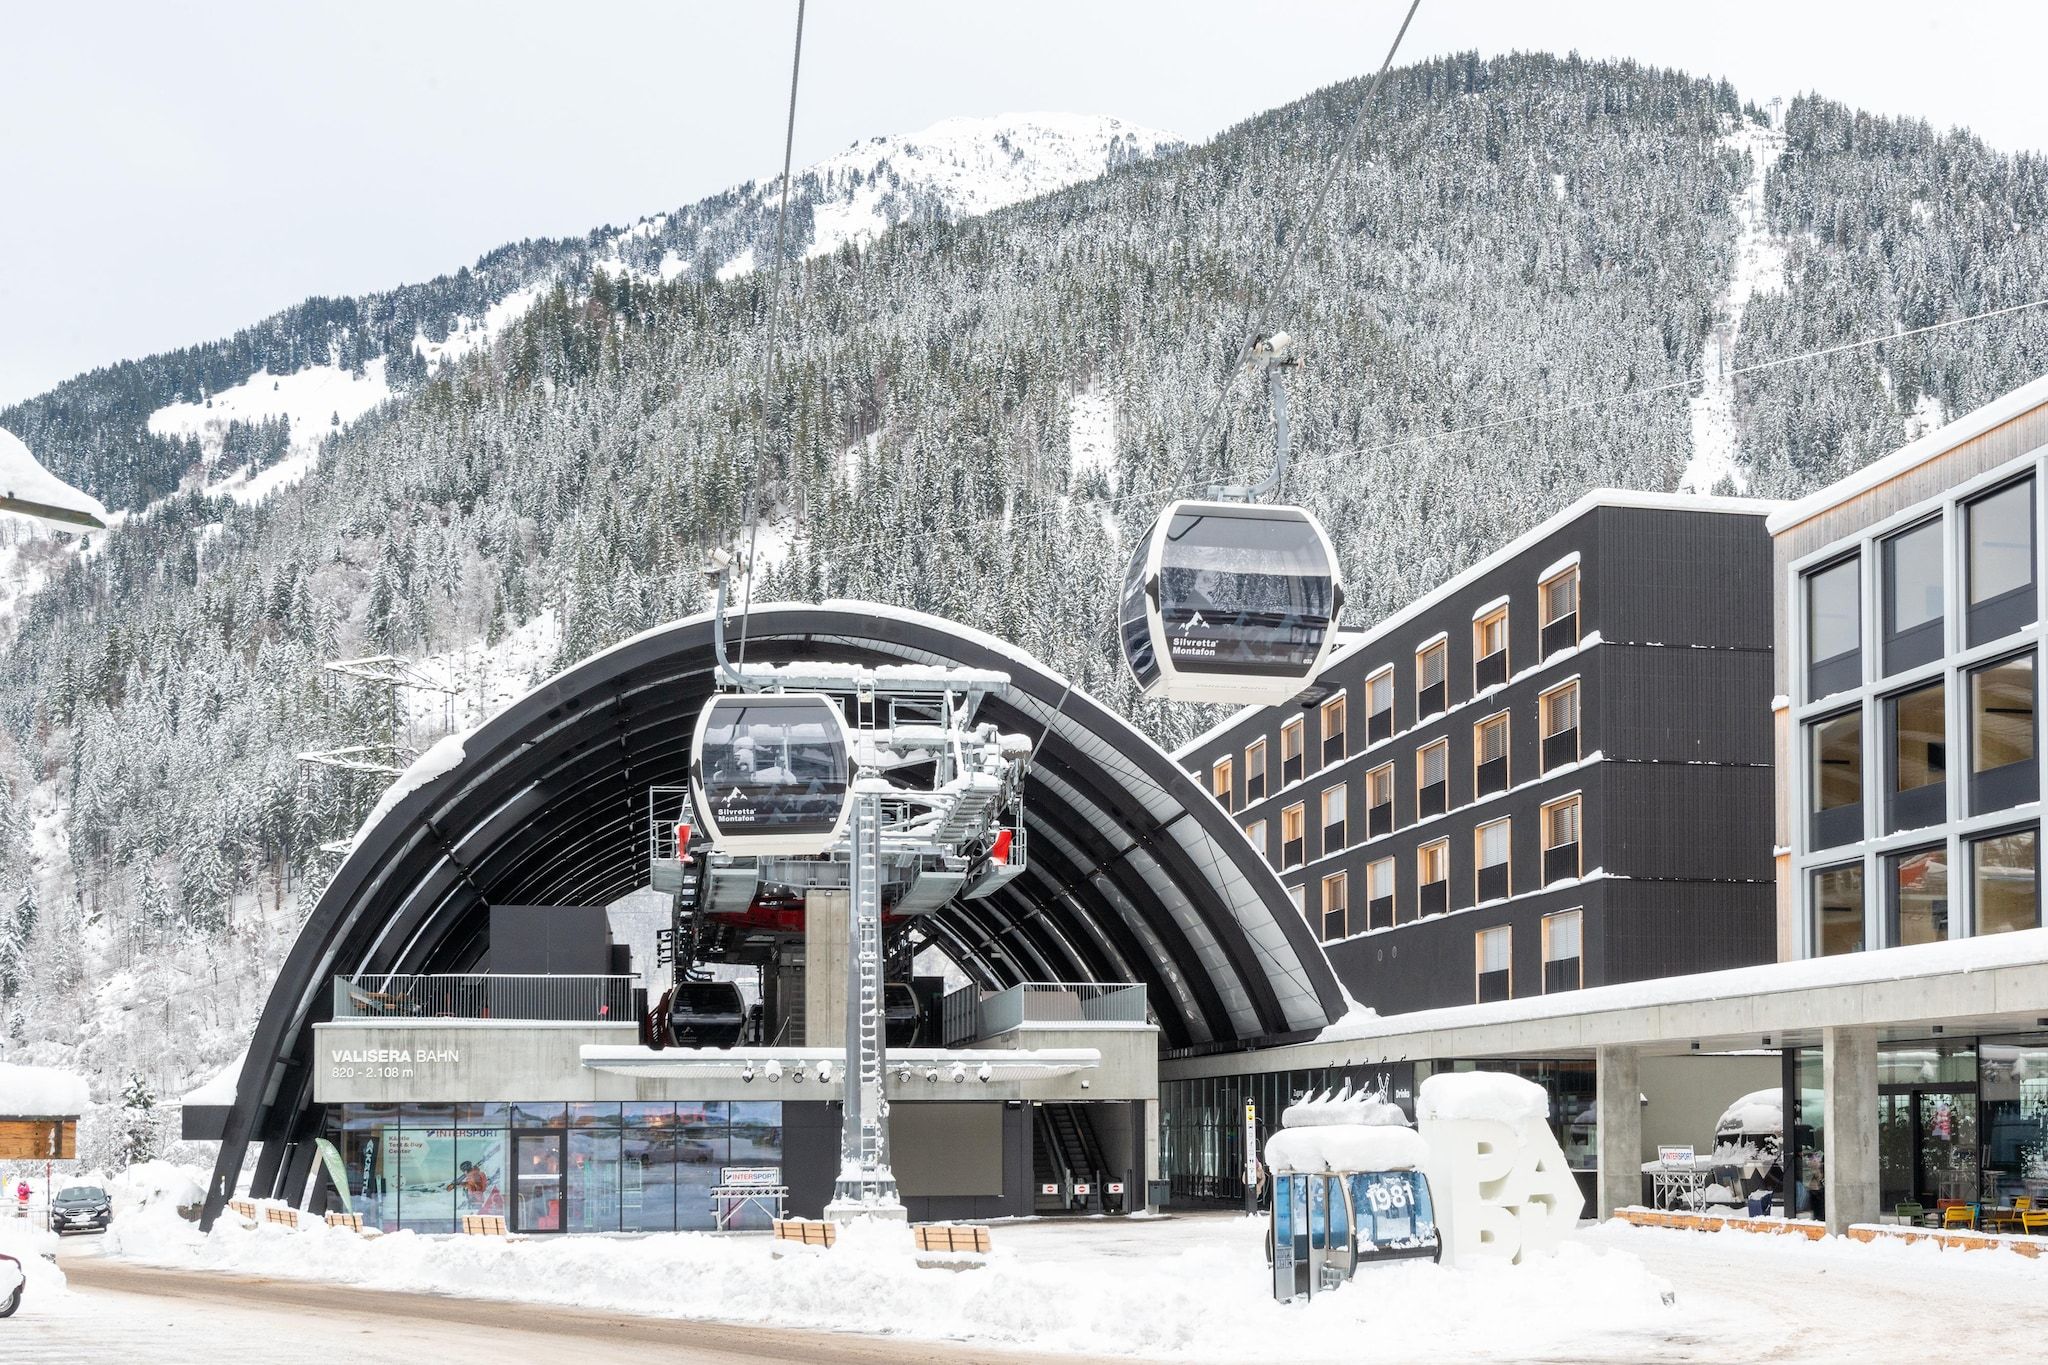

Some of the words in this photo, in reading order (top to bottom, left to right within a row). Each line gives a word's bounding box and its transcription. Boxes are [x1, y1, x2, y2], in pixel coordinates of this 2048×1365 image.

[1172, 637, 1217, 648] Silvretta
[1172, 646, 1216, 656] Montafon
[331, 1049, 412, 1063] VALISERA
[416, 1049, 460, 1063] BAHN
[332, 1067, 354, 1078] 820
[366, 1067, 399, 1078] 2.108
[402, 1068, 414, 1078] m
[436, 1129, 498, 1137] INTERSPORT
[1366, 1180, 1415, 1212] 1981
